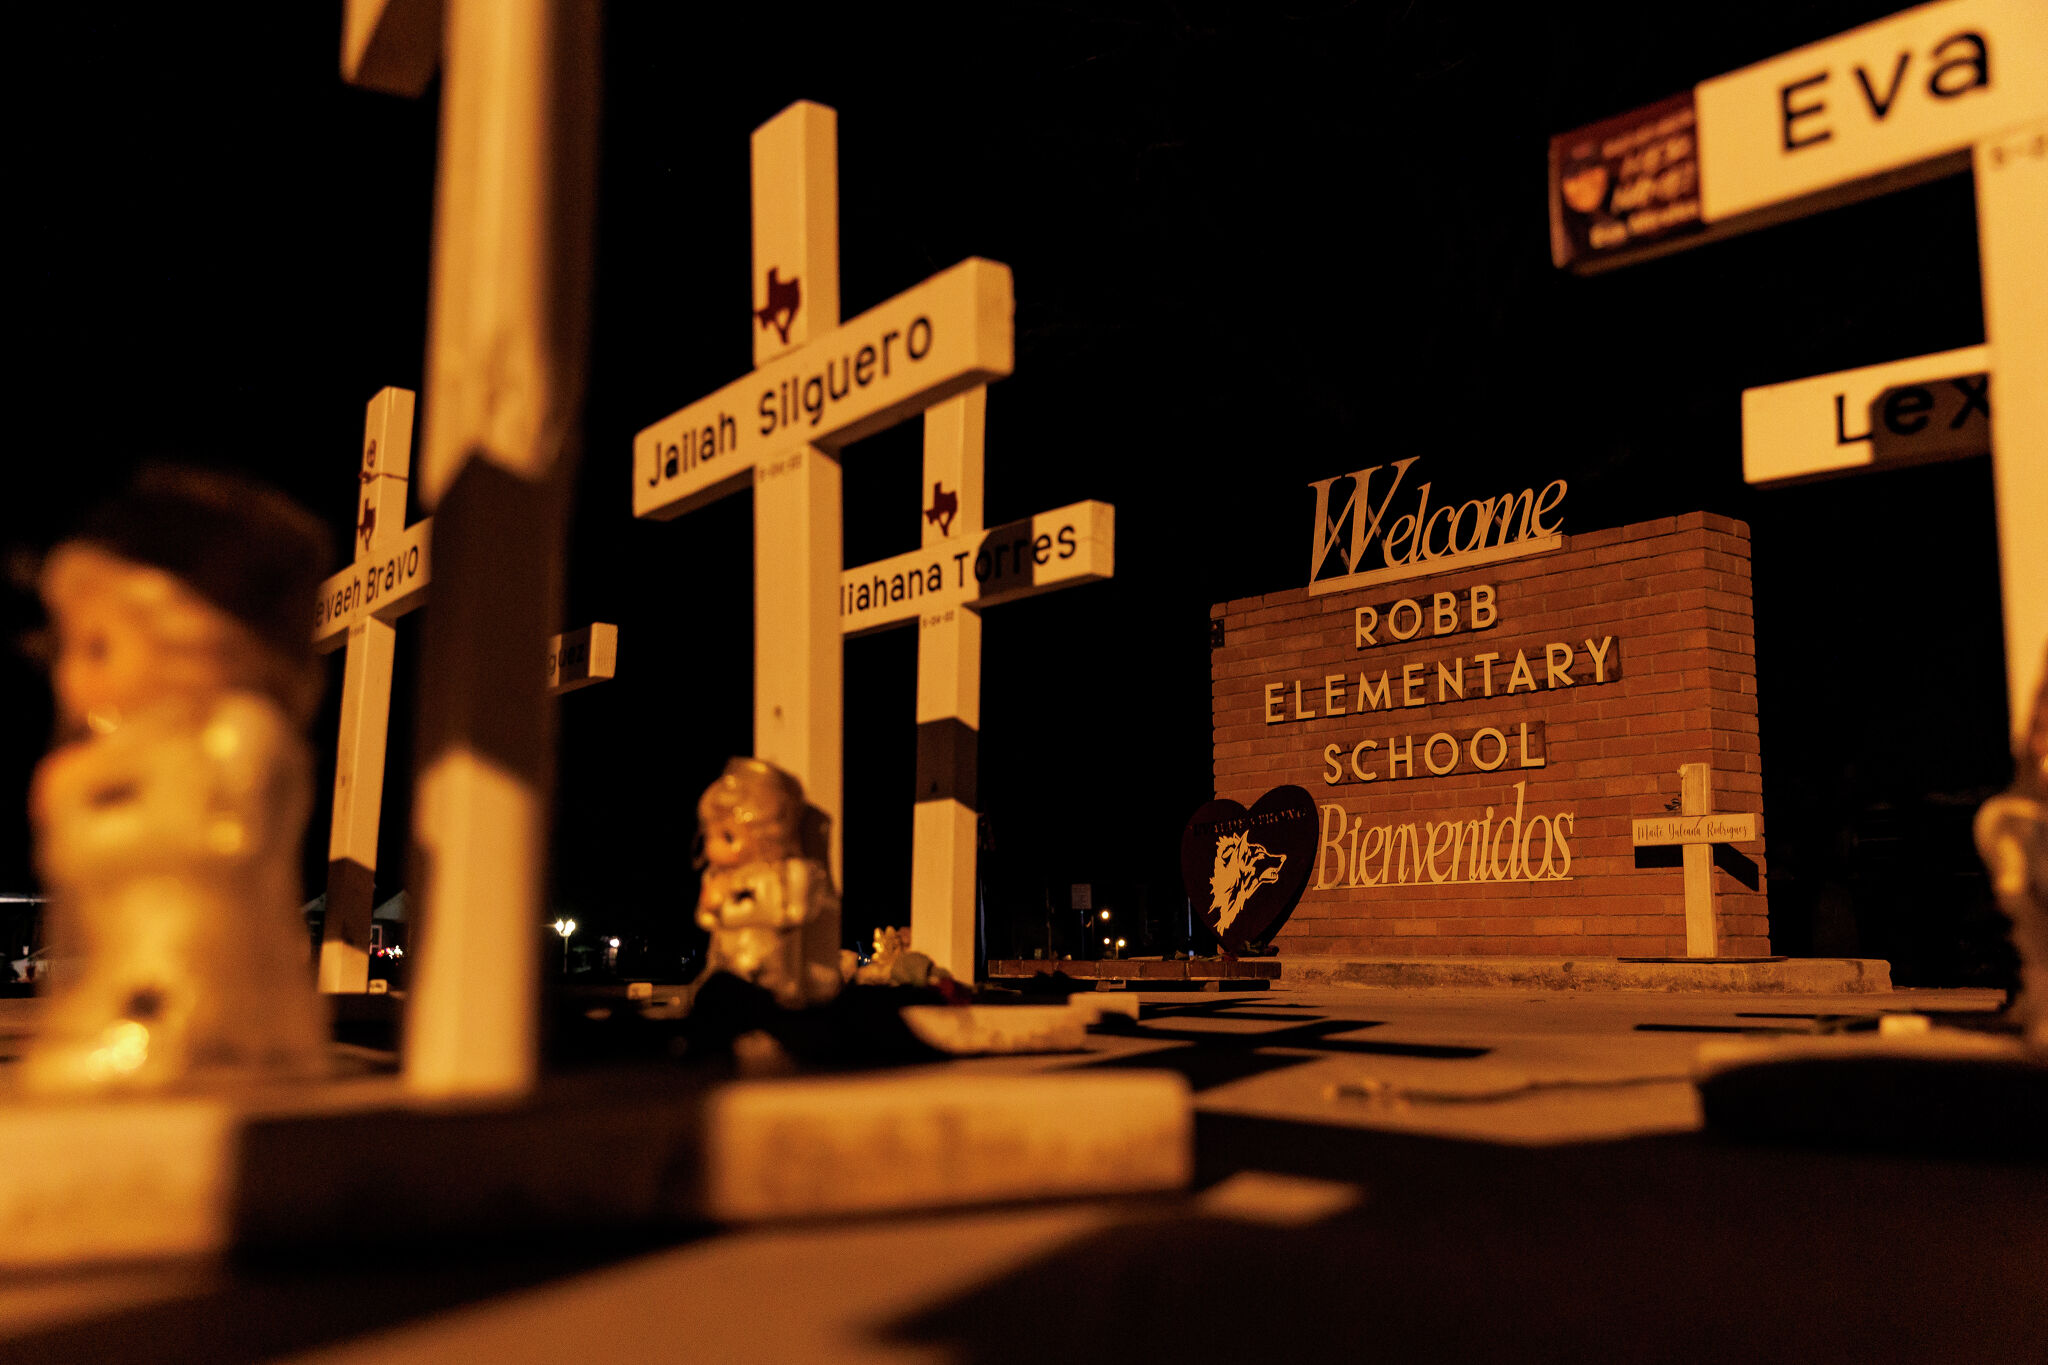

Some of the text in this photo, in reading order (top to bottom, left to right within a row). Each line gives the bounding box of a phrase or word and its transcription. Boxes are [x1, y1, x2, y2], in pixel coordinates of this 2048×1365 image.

[1779, 31, 1989, 153] Eva
[649, 314, 932, 487] Jailah Silguero
[1835, 376, 1989, 445] Lex
[1307, 454, 1569, 583] Welcome
[315, 544, 419, 628] evaeh Bravo
[840, 525, 1077, 617] liahana Torres
[1354, 584, 1499, 650] ROBB
[1264, 635, 1614, 725] ELEMENTARY
[1322, 722, 1546, 786] SCHOOL
[1316, 781, 1575, 888] Bienvenidos
